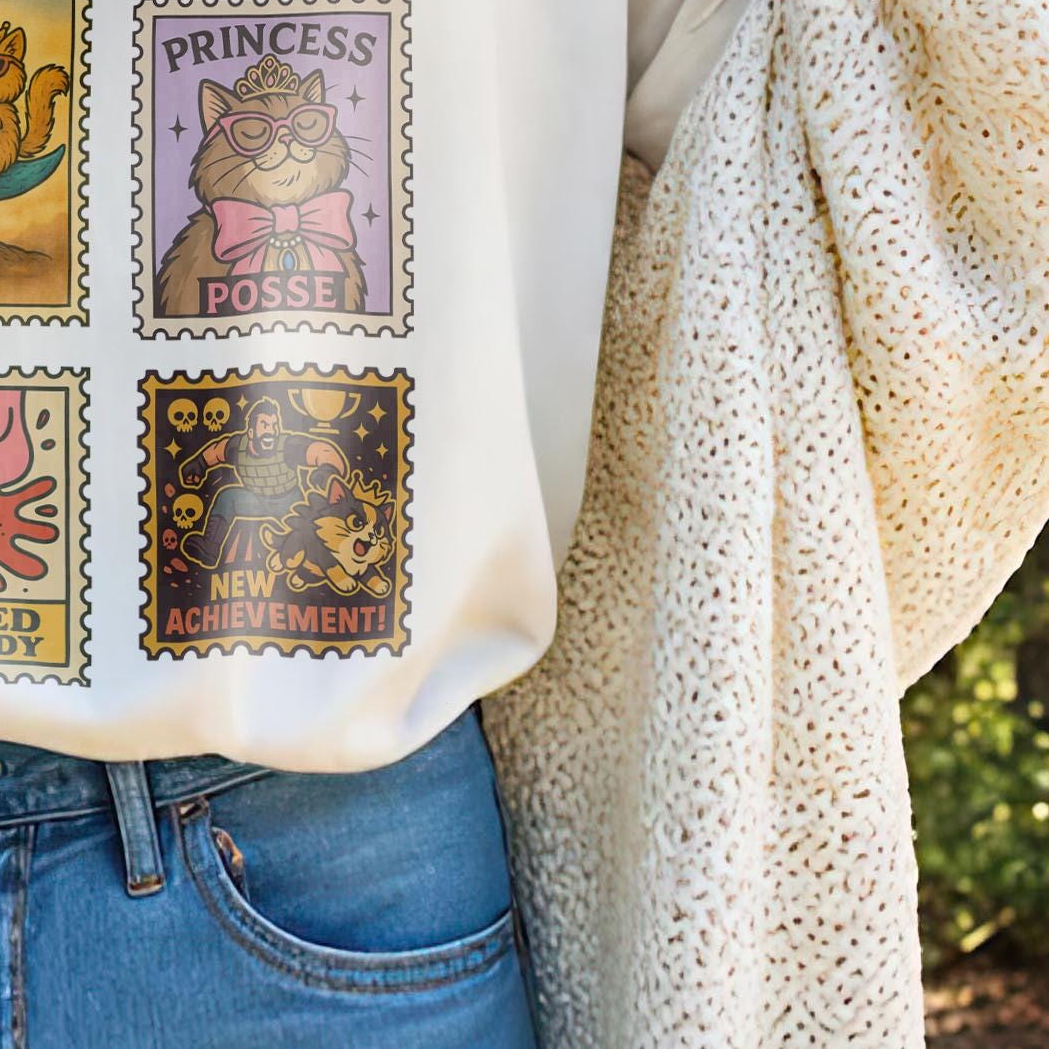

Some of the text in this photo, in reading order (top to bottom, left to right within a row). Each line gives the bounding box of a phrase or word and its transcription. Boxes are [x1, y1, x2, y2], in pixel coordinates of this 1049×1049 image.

[161, 22, 377, 73] PRINCESS
[207, 276, 337, 314] POSSE
[210, 570, 276, 601] NEW
[165, 601, 387, 635] ACHIEVEMENT!
